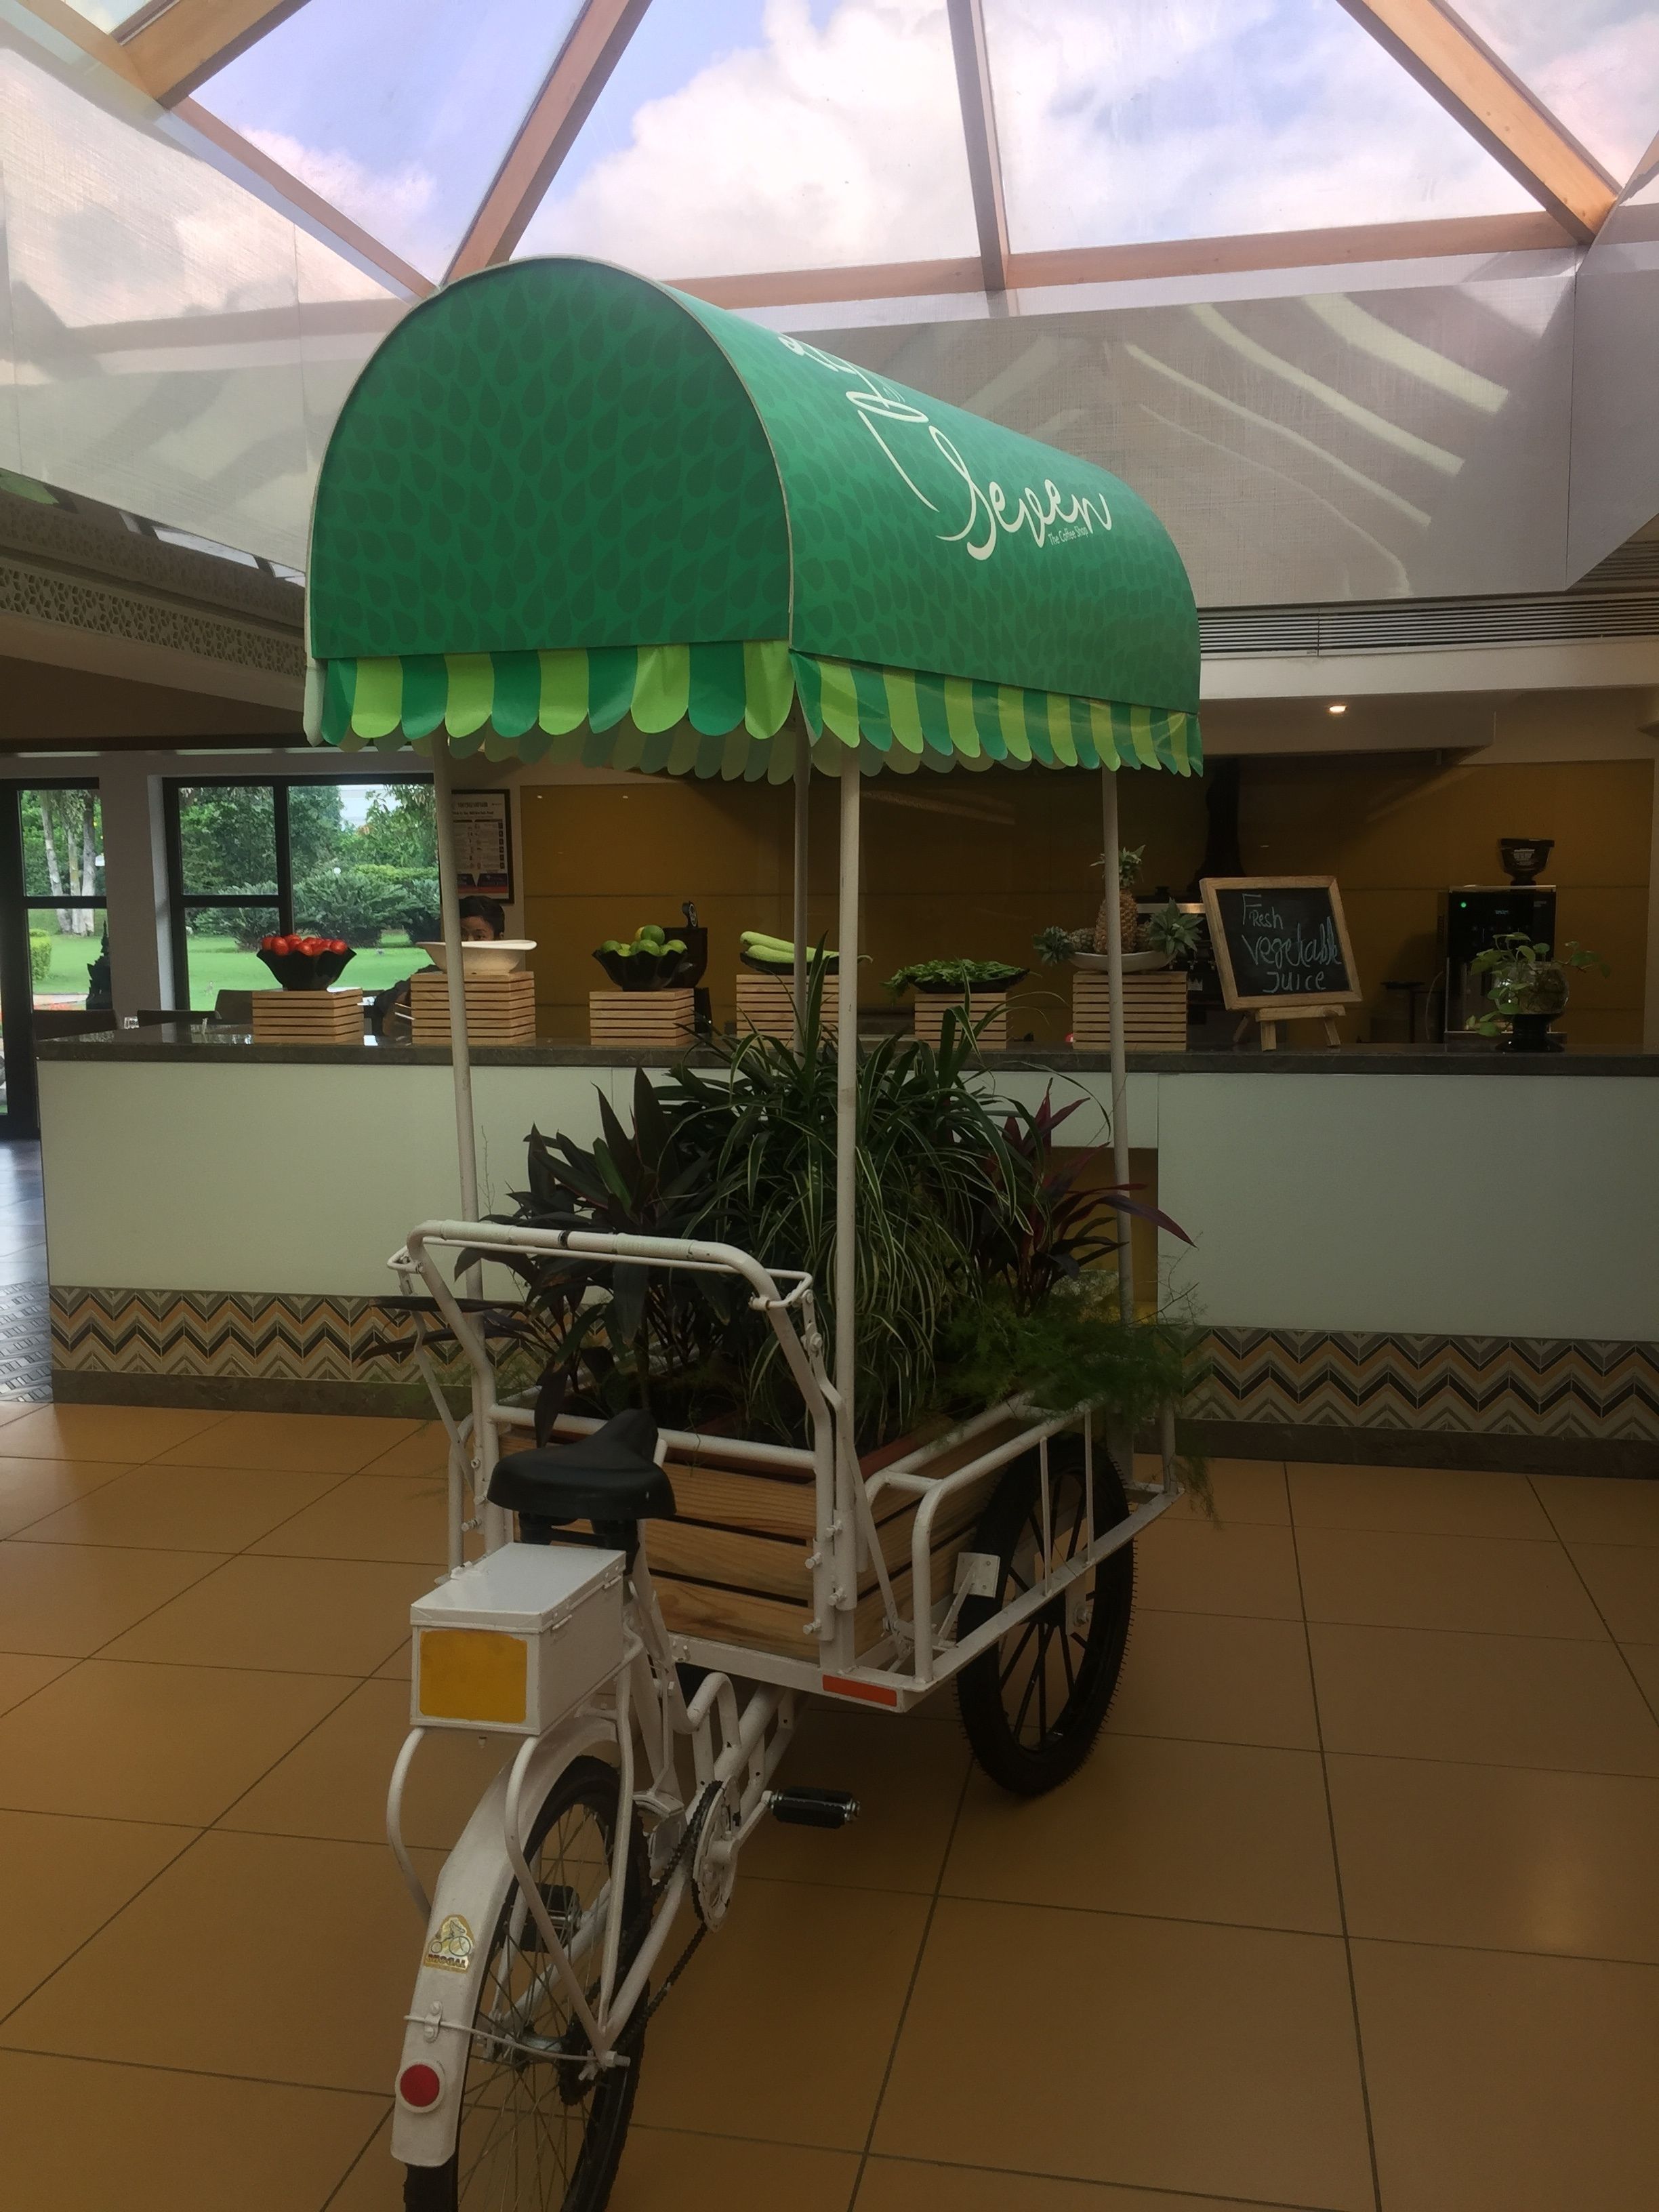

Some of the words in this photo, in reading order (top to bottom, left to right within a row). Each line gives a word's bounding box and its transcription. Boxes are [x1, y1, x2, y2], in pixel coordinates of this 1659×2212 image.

[928, 425, 1113, 560] Seven
[1047, 532, 1060, 546] The
[1059, 527, 1077, 543] Coffee
[1074, 525, 1088, 538] Shop
